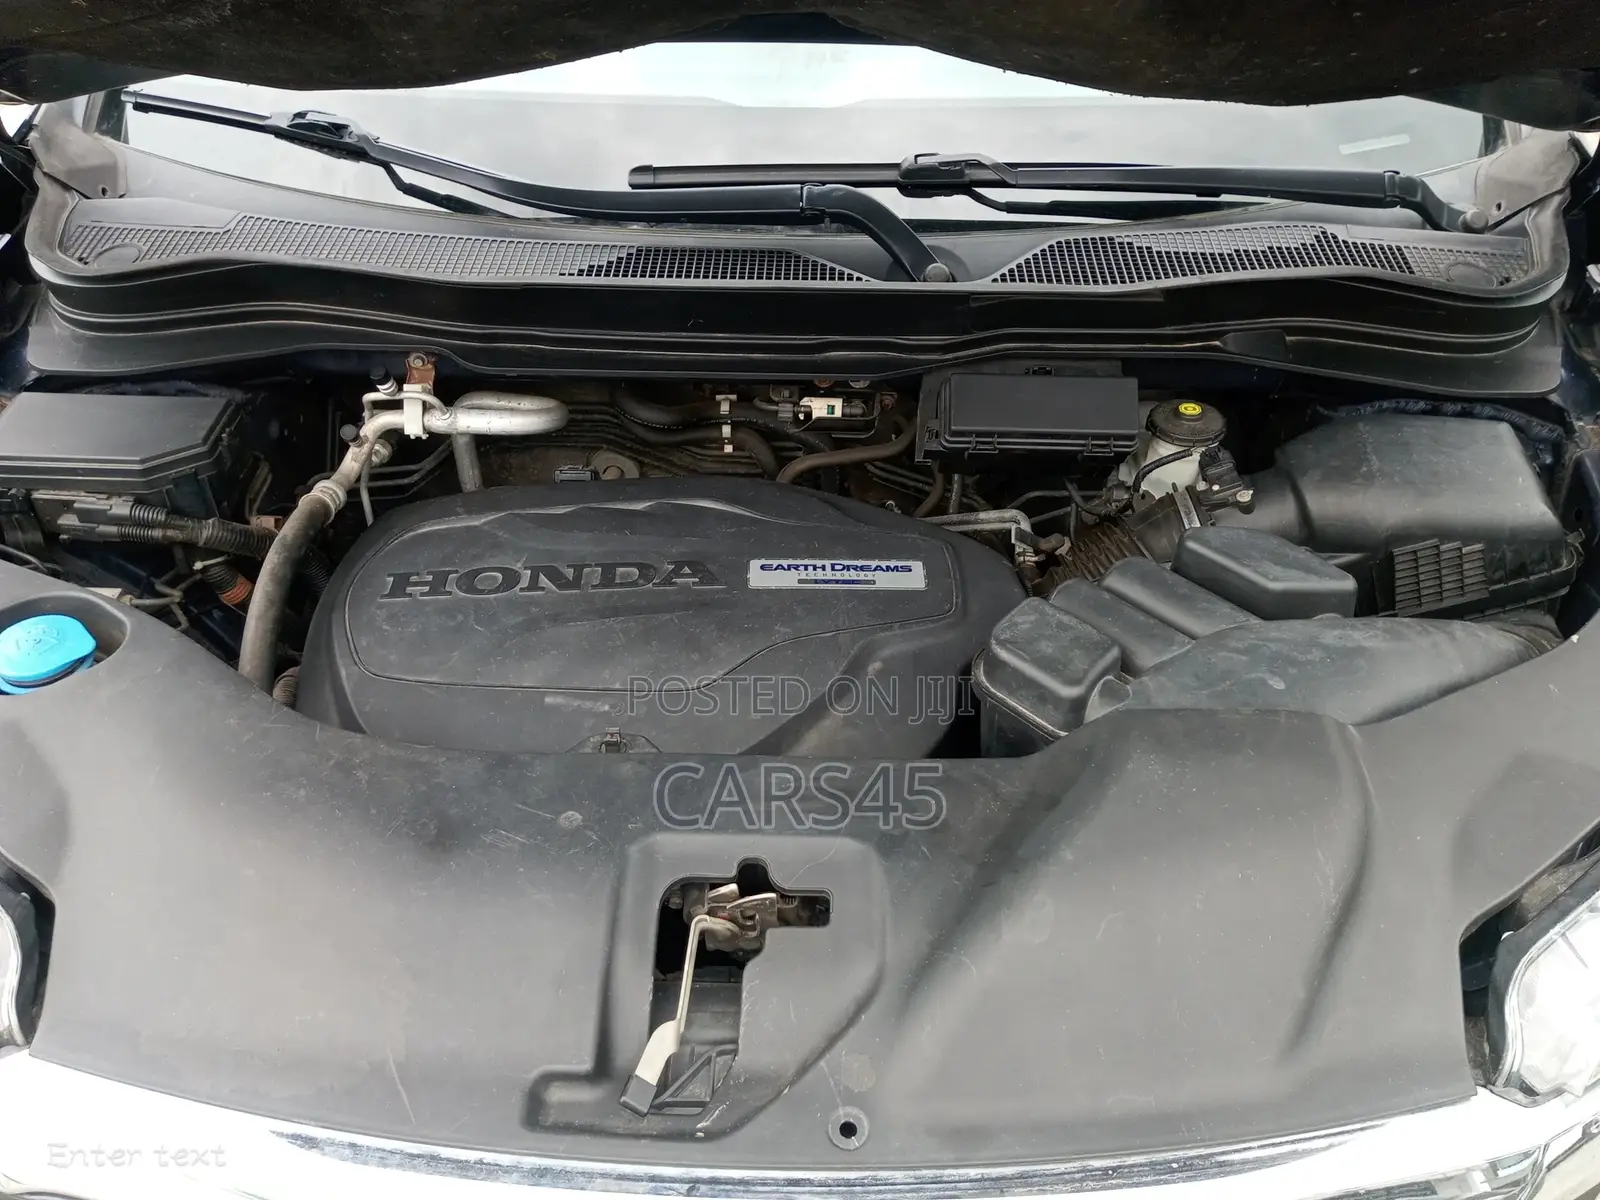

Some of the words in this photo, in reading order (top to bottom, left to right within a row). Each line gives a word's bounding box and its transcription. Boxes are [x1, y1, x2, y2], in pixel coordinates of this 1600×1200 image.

[379, 560, 727, 600] HONDA
[759, 563, 827, 572] EARTH
[830, 562, 913, 573] DREAMS
